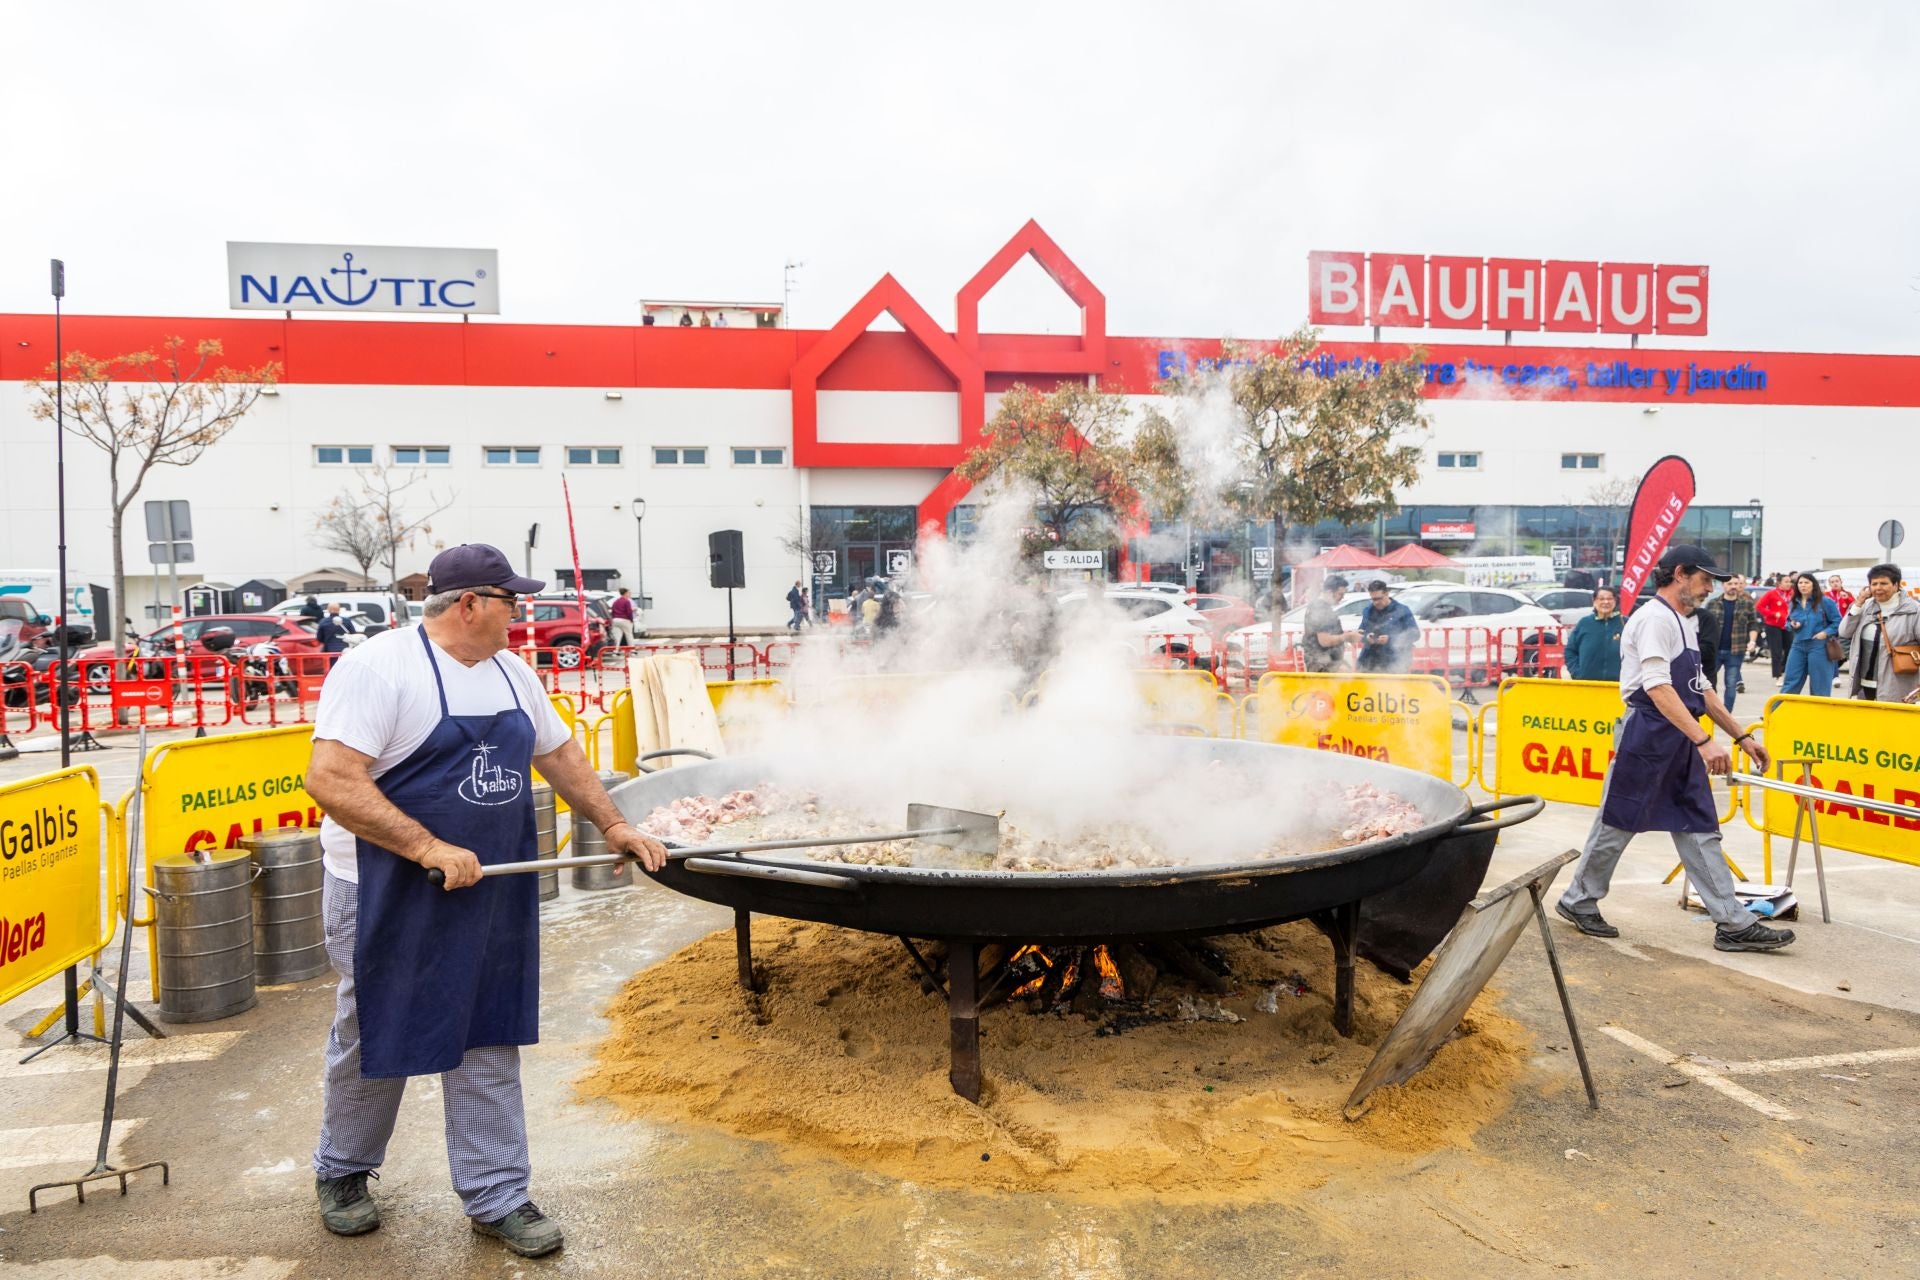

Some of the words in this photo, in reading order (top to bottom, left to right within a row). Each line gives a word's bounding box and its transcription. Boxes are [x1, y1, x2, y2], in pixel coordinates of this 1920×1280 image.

[240, 252, 476, 308] NAUTIC
[1320, 262, 1702, 325] BAUHAUS
[1586, 361, 1657, 388] taller
[1664, 368, 1681, 395] y
[1687, 362, 1767, 395] jardín
[1063, 555, 1100, 564] SALIDA
[1622, 494, 1683, 595] BAUHAUS
[1346, 692, 1420, 714] Galbis
[1347, 714, 1378, 723] Paellas
[1381, 715, 1420, 726] Gigantes
[1522, 715, 1588, 734] PAELLAS
[1593, 720, 1615, 736] GI
[1522, 742, 1616, 781] GAL
[1793, 740, 1869, 765] PAELLAS
[181, 781, 257, 812] PAELLAS
[262, 774, 304, 797] GIGA
[0, 804, 78, 861] Galbis
[3, 858, 38, 881] Paellas
[40, 843, 79, 868] Gigantes
[0, 911, 46, 967] lera
